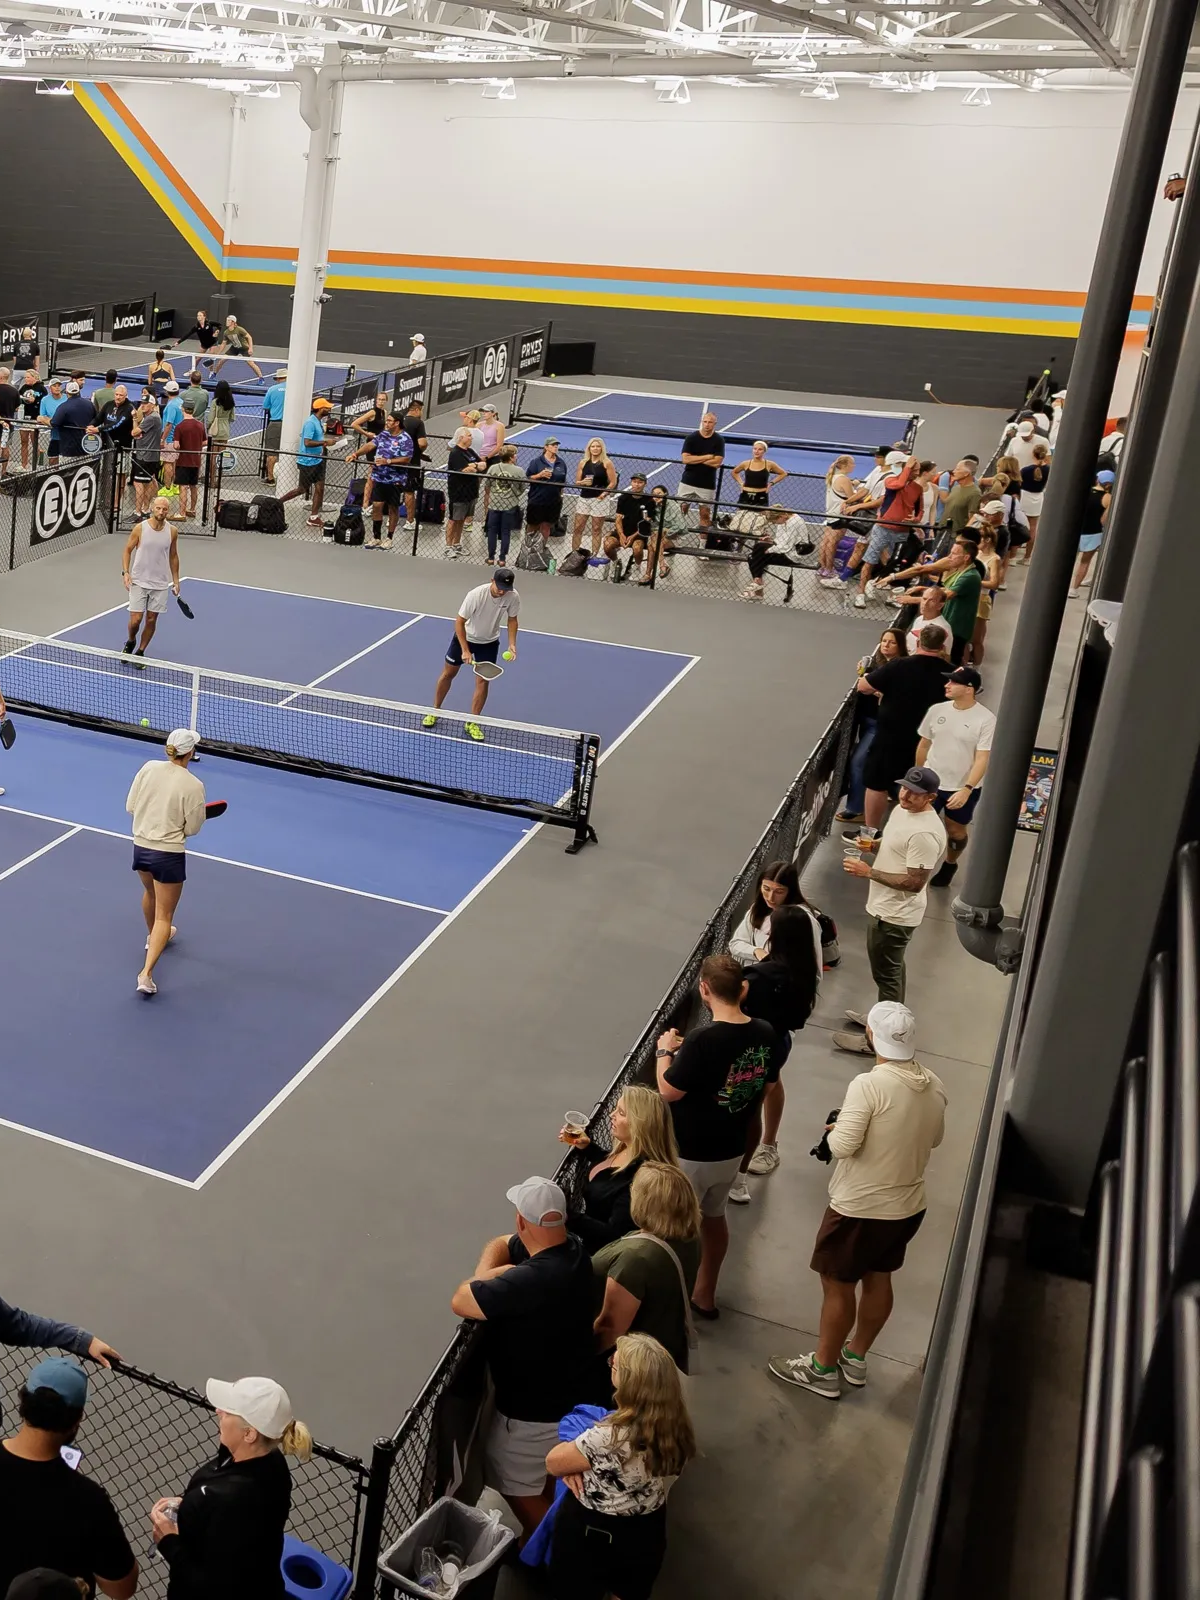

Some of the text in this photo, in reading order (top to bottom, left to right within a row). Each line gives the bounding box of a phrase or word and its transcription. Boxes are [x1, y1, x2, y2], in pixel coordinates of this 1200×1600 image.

[120, 314, 145, 329] JOOLA
[2, 326, 37, 344] PRYS
[521, 338, 543, 359] PRYES
[1031, 754, 1055, 766] LAM
